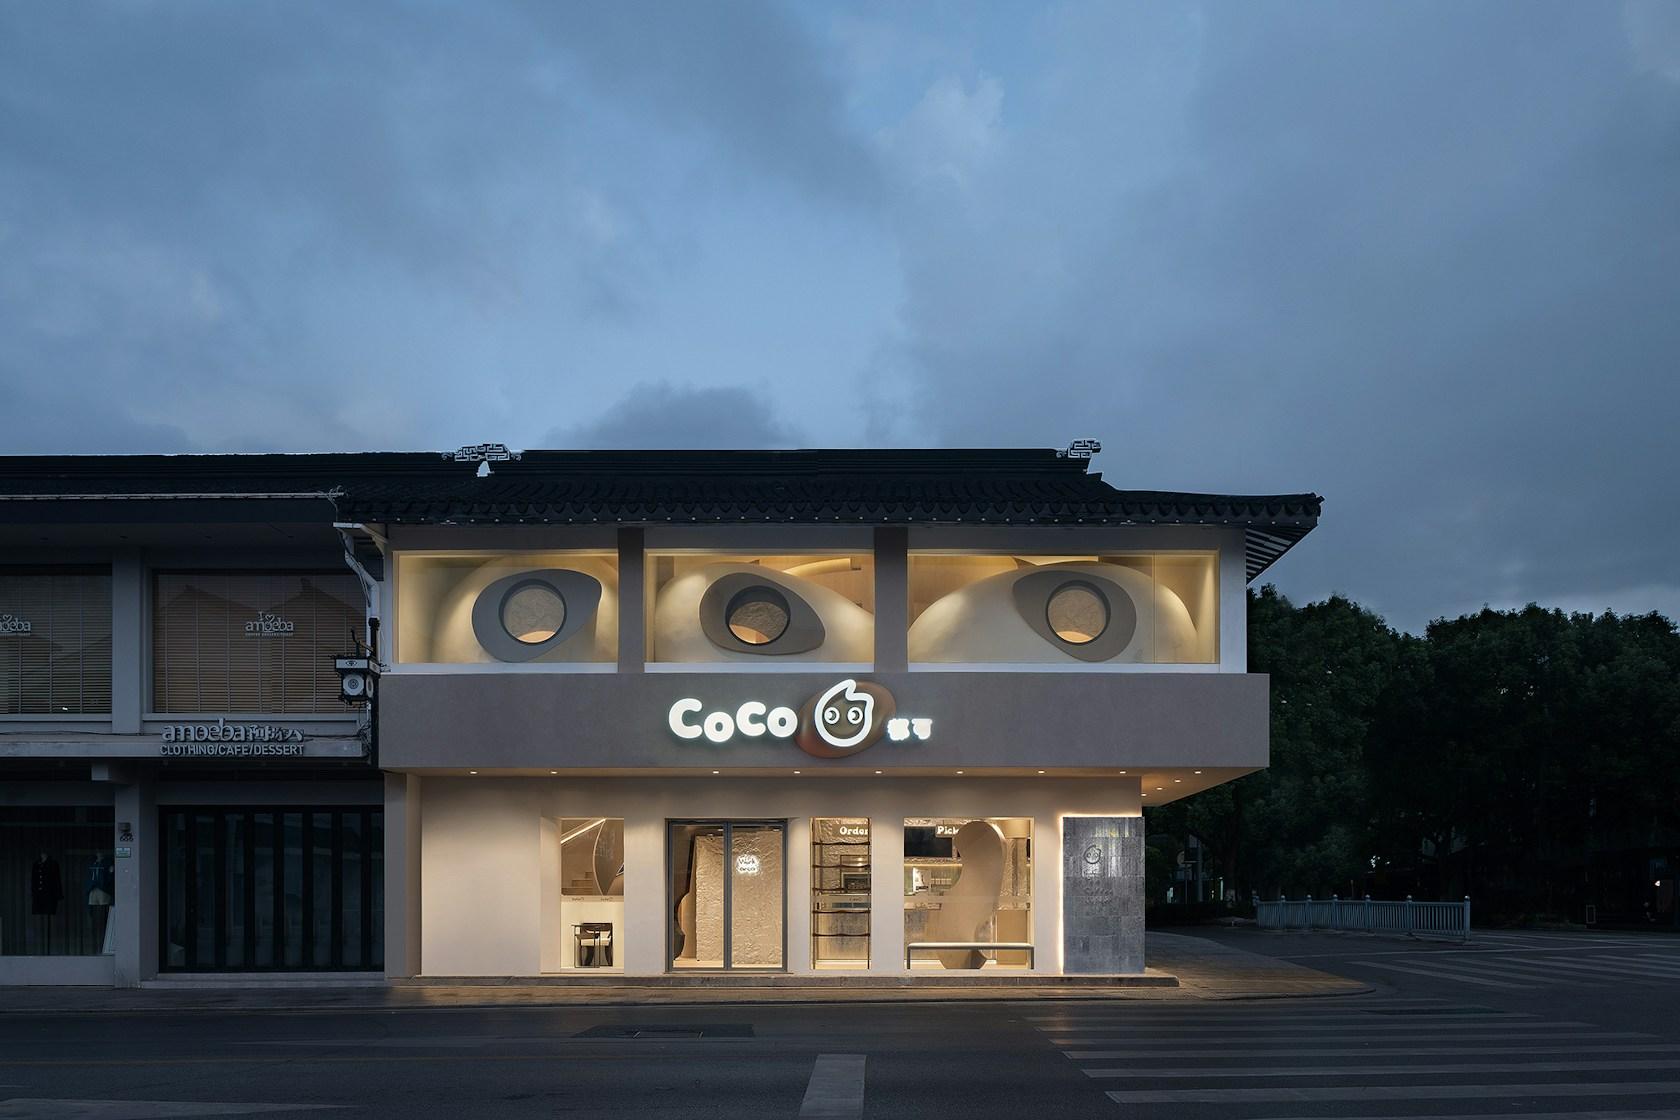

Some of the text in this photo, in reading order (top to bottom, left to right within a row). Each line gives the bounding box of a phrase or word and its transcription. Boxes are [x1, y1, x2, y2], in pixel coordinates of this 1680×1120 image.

[245, 617, 294, 631] amoeba
[668, 698, 798, 742] CoCo
[161, 718, 246, 742] amoeba
[160, 744, 304, 756] CLOTHING/CAFE/DESSERT
